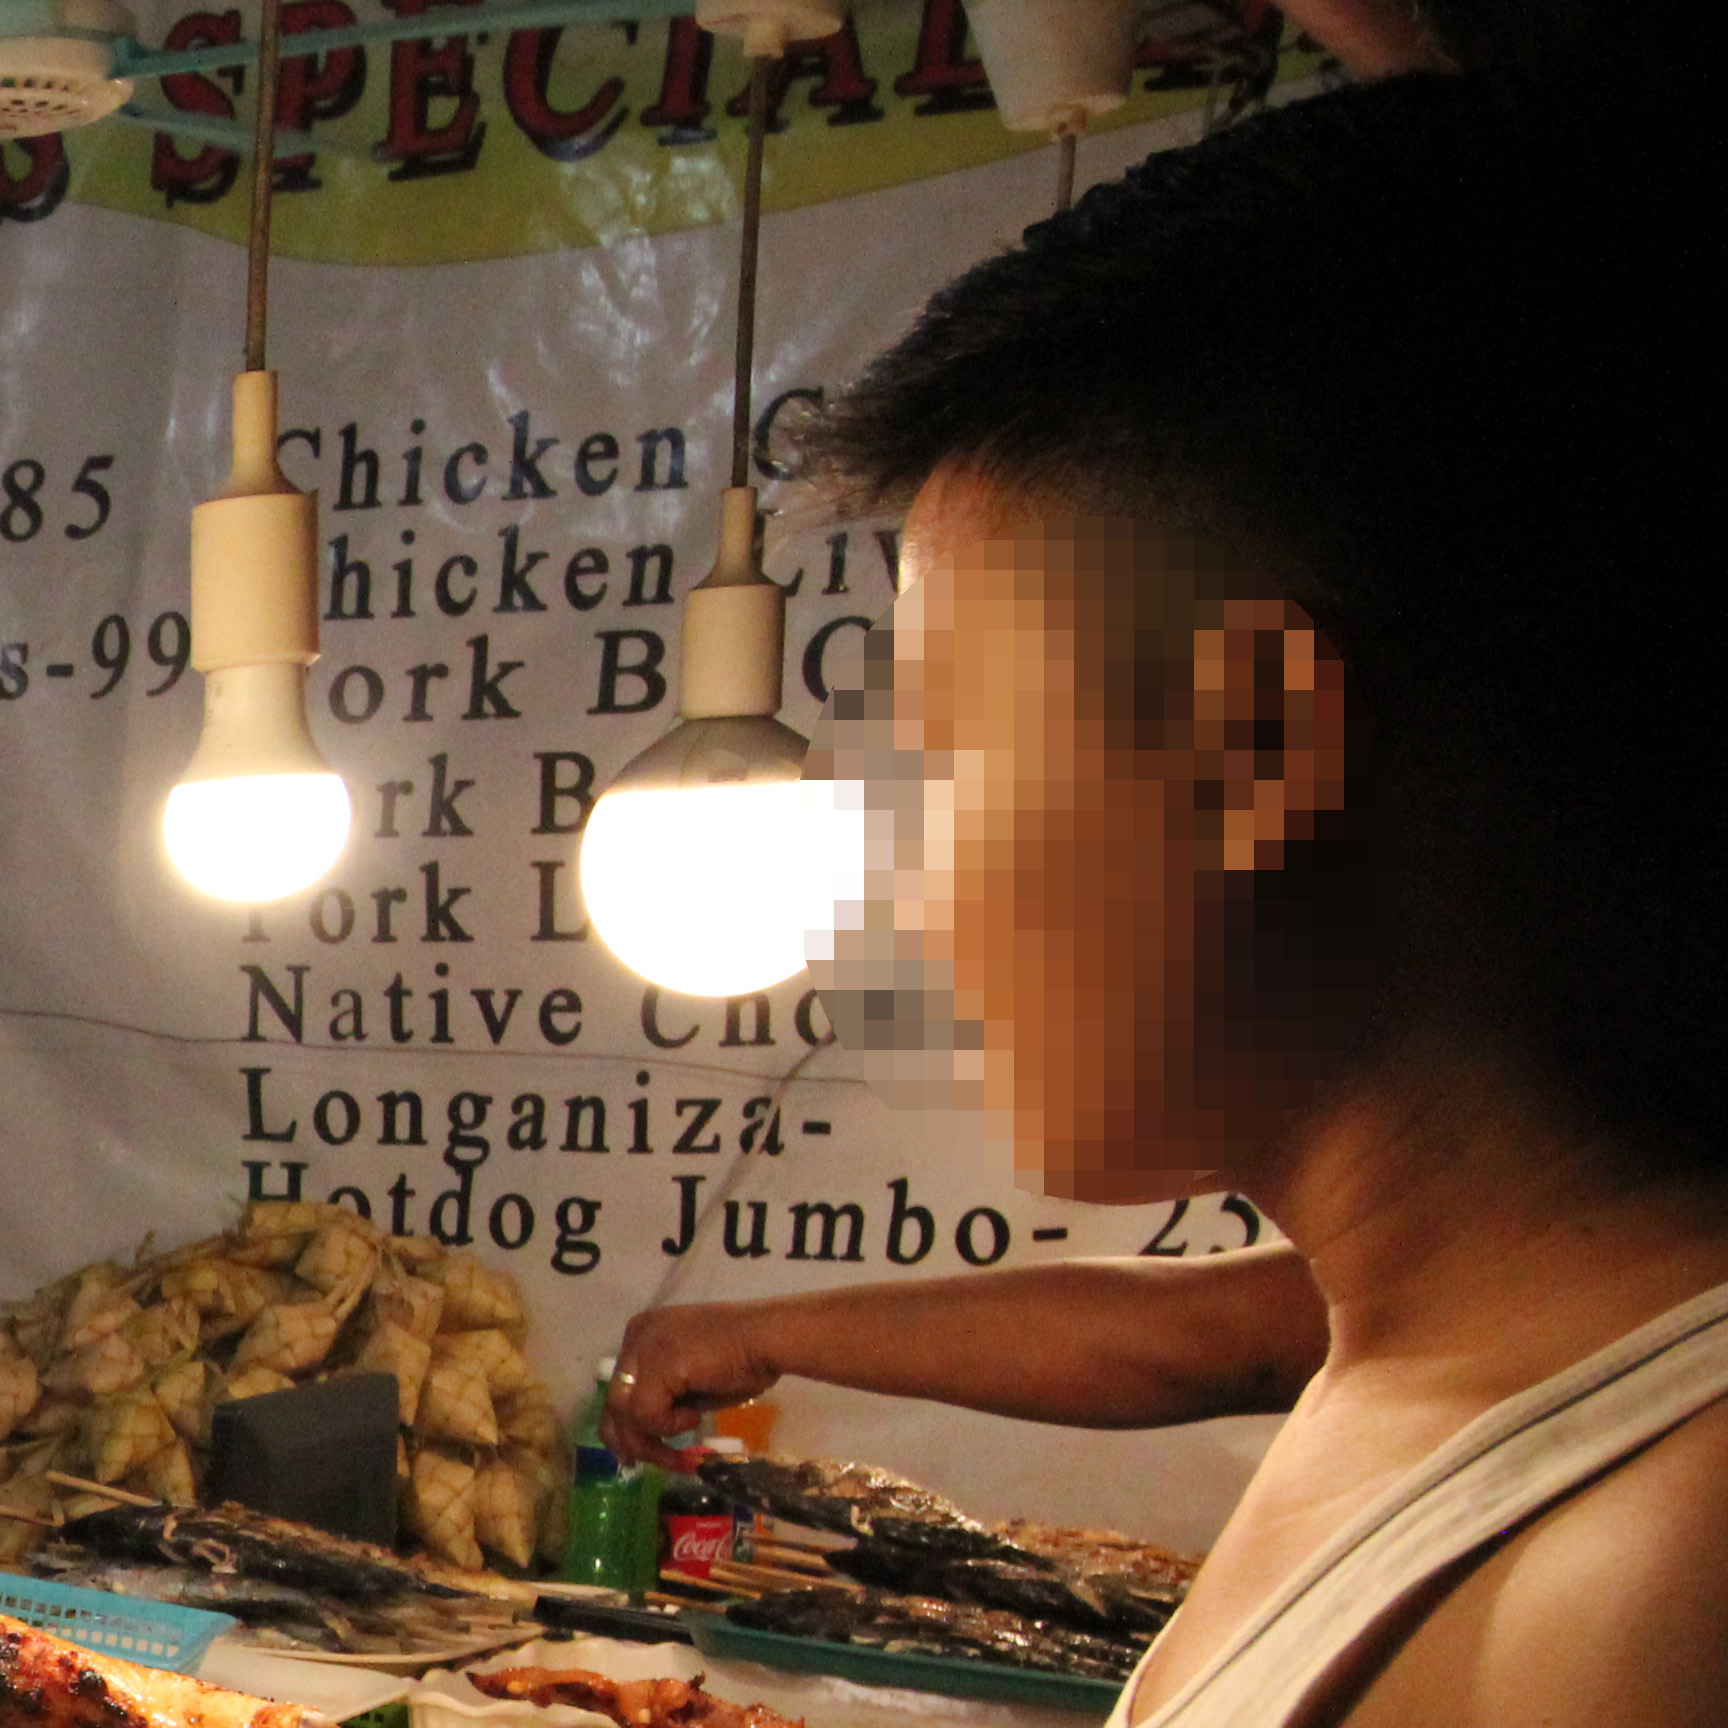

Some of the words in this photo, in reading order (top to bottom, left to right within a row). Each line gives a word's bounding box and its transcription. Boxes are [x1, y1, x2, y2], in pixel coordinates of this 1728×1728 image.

[240, 963, 584, 1047] Native
[239, 1067, 832, 1175] Longaniza-
[662, 1175, 1068, 1267] Jumbo-
